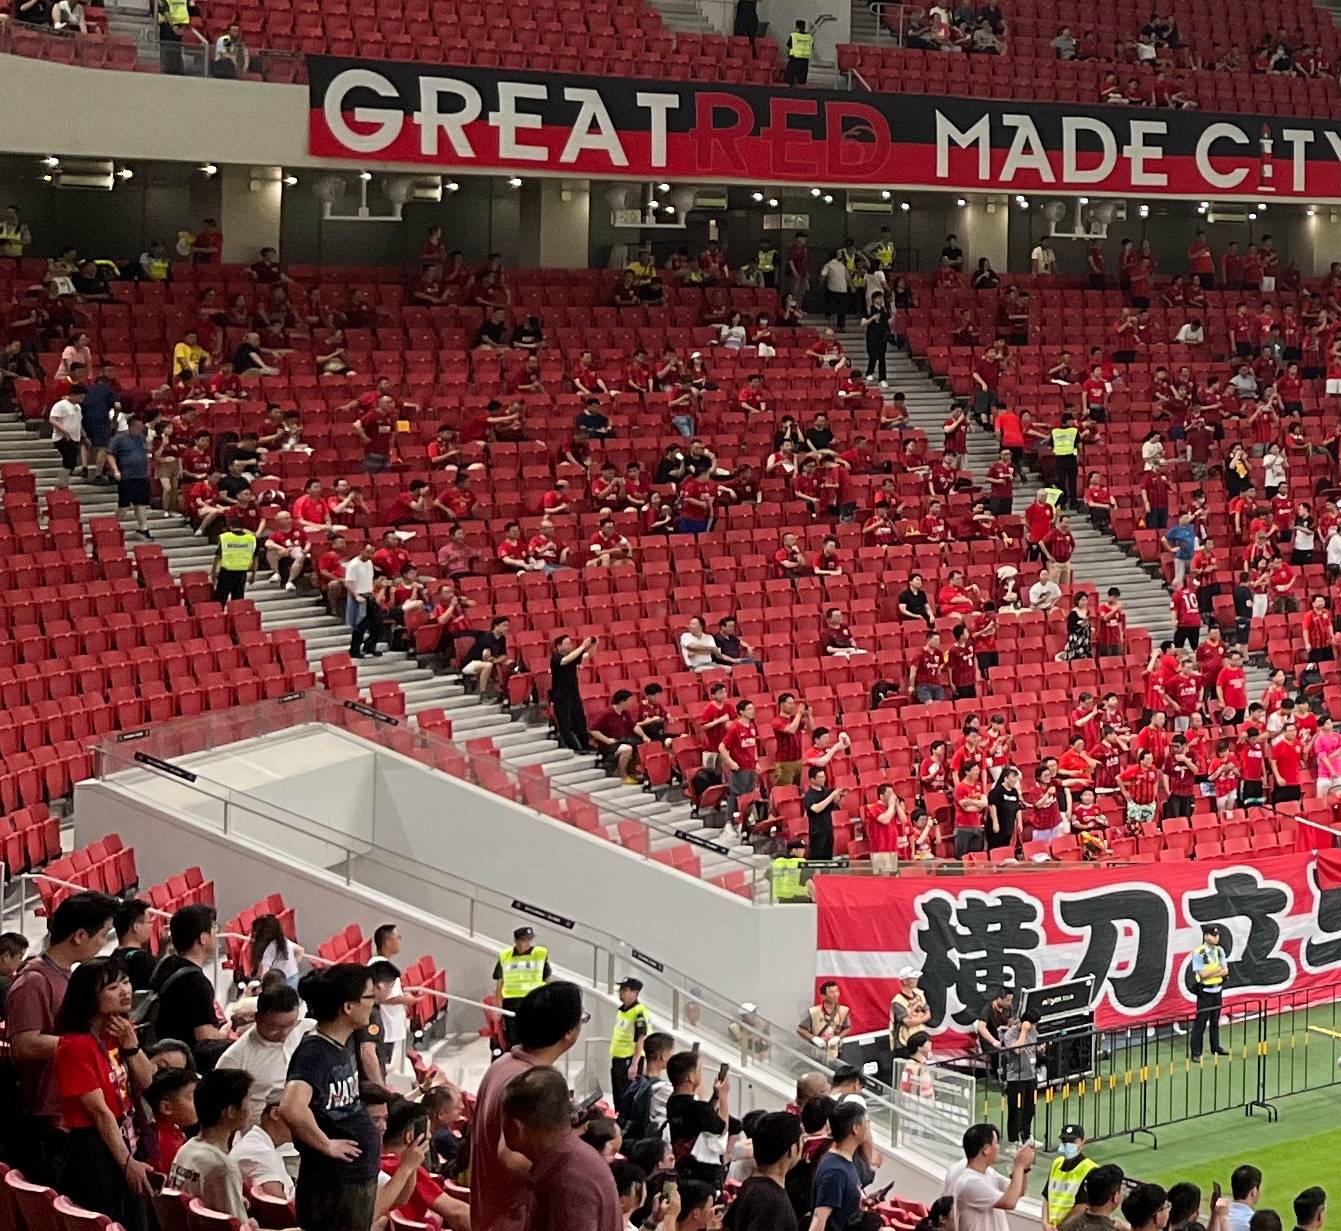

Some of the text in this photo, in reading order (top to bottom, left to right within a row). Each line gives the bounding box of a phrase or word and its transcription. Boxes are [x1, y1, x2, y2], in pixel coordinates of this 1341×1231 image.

[323, 68, 679, 168] GREAT
[690, 91, 892, 179] RED
[935, 109, 1168, 186] MADE
